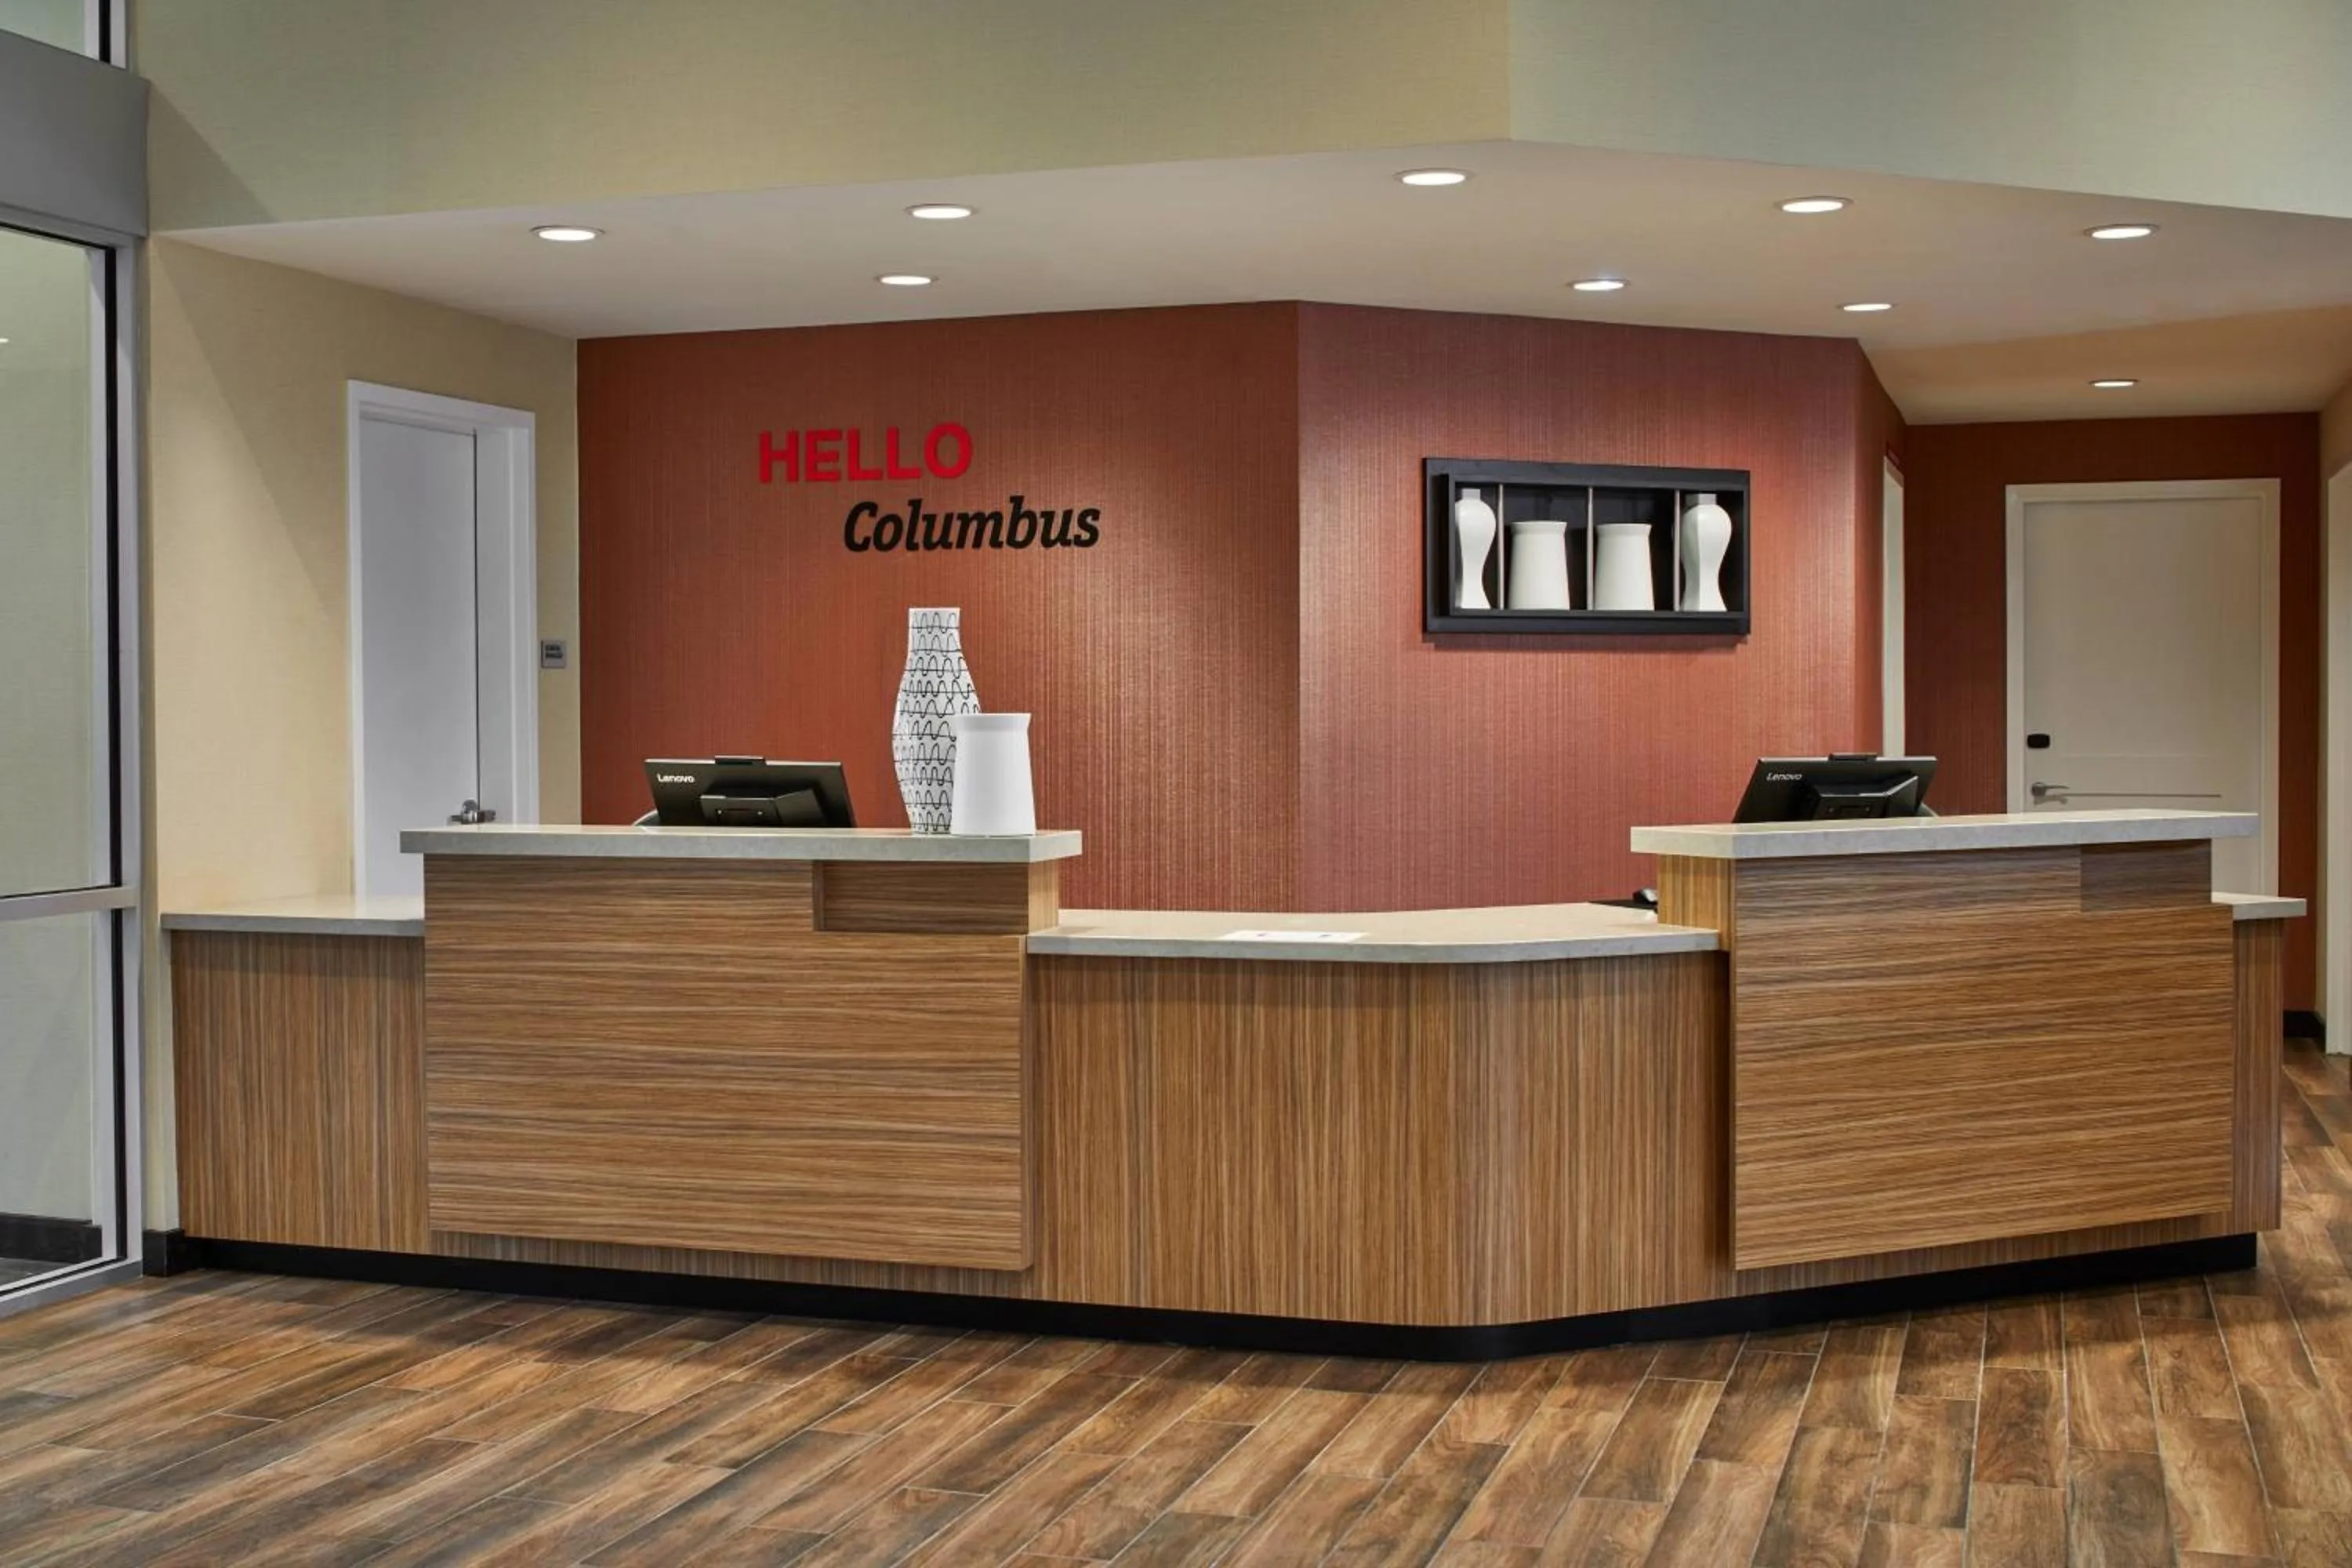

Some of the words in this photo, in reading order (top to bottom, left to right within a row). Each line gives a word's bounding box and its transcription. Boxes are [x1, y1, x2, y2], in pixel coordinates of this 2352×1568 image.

[759, 423, 973, 482] HELLO
[844, 495, 1101, 552] Columbus
[657, 773, 695, 783] Lenovo
[1766, 772, 1802, 781] Lenovo
